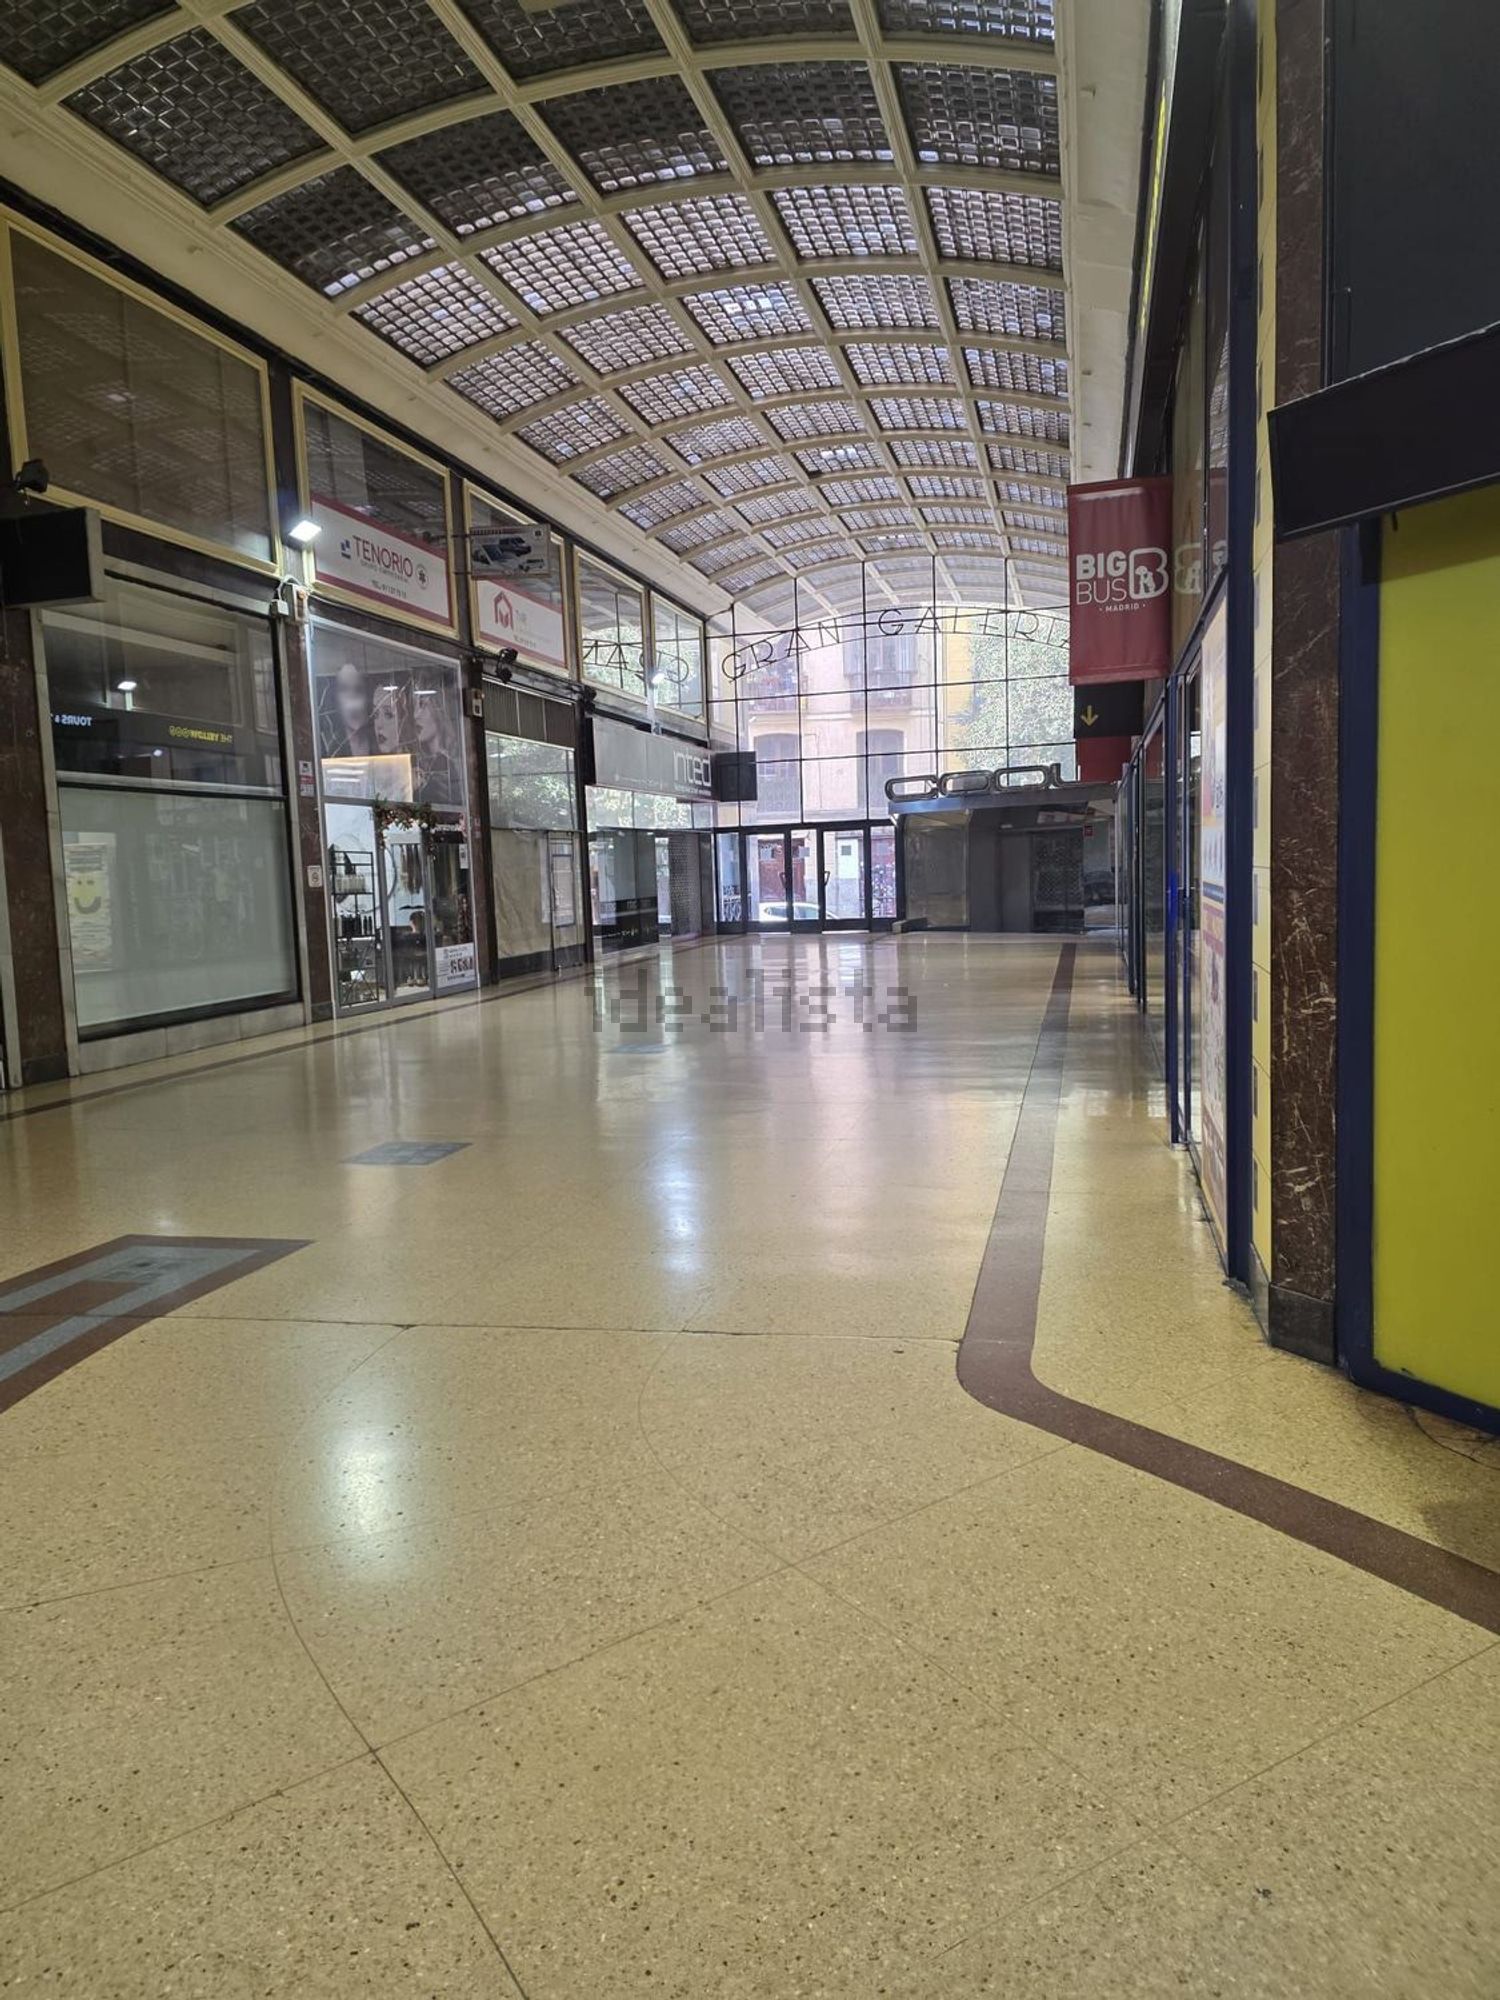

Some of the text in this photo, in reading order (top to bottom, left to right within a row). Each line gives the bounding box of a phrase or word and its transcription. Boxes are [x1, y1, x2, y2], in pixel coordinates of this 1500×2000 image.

[352, 535, 413, 578] TENORIO
[1075, 550, 1127, 580] BIG
[1076, 578, 1127, 605] BUS
[1105, 603, 1140, 612] MADRID
[721, 617, 841, 683] GRAN
[884, 762, 1096, 803] COOL
